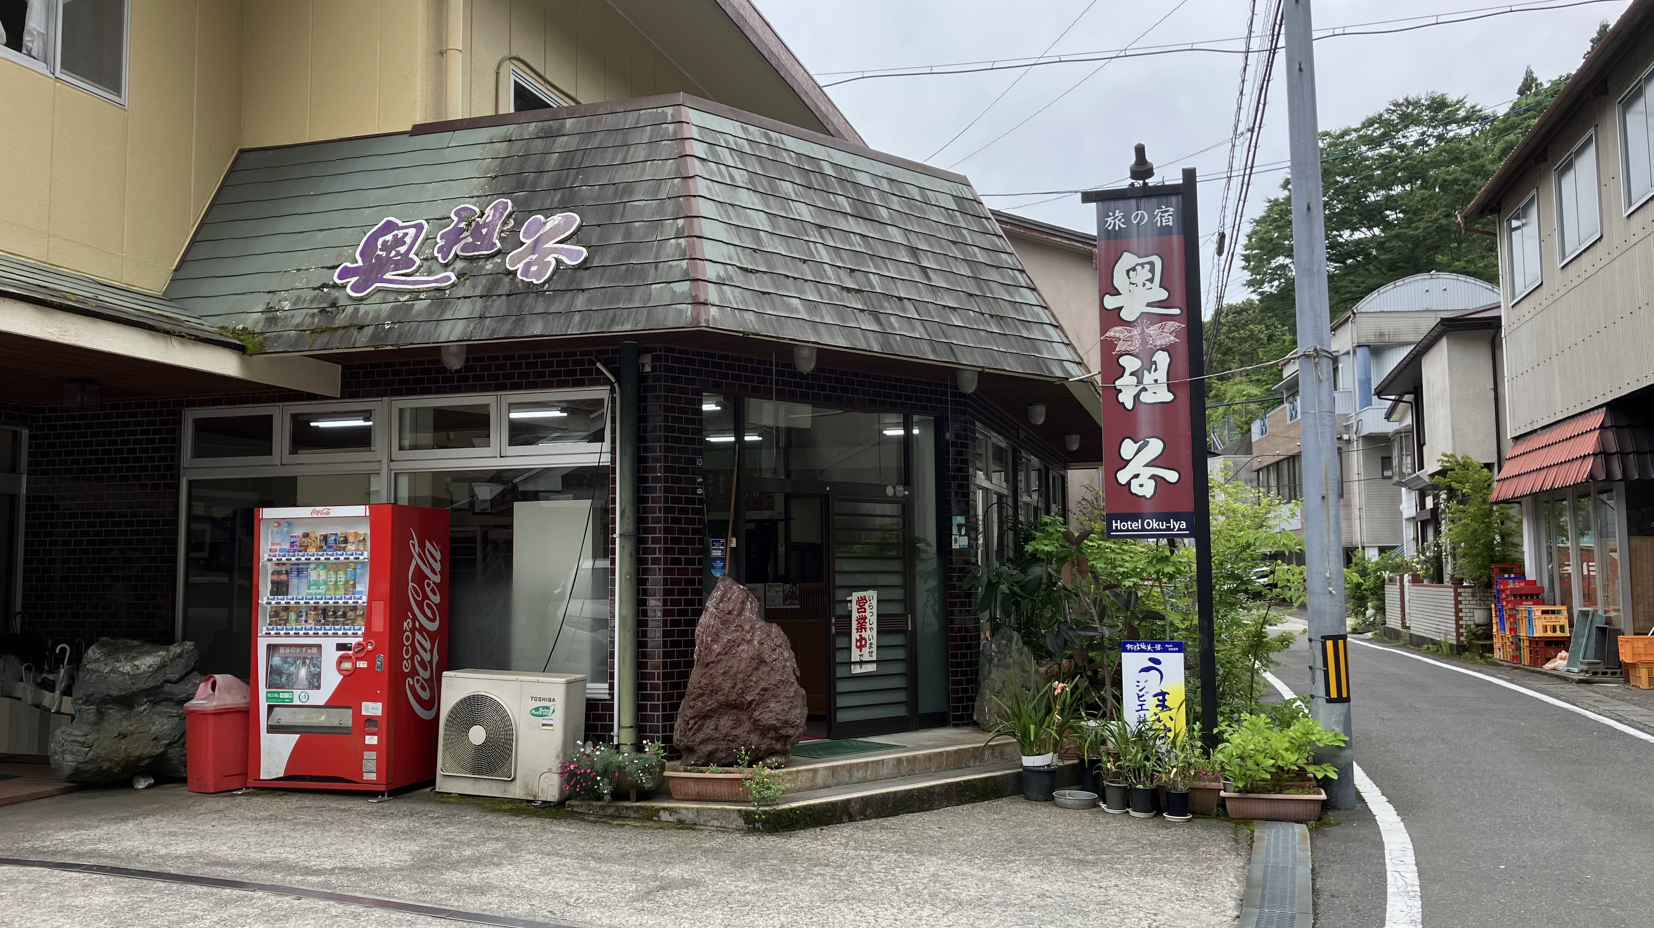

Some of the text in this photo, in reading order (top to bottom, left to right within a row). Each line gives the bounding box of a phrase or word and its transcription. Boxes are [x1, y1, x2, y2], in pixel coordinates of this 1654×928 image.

[333, 198, 588, 297] 奥祖谷
[1104, 205, 1175, 230] 旅の宿
[1102, 250, 1182, 498] 奥祖谷
[1112, 518, 1187, 532] Hotel Oku-Iya
[406, 527, 442, 720] Coca-Cola
